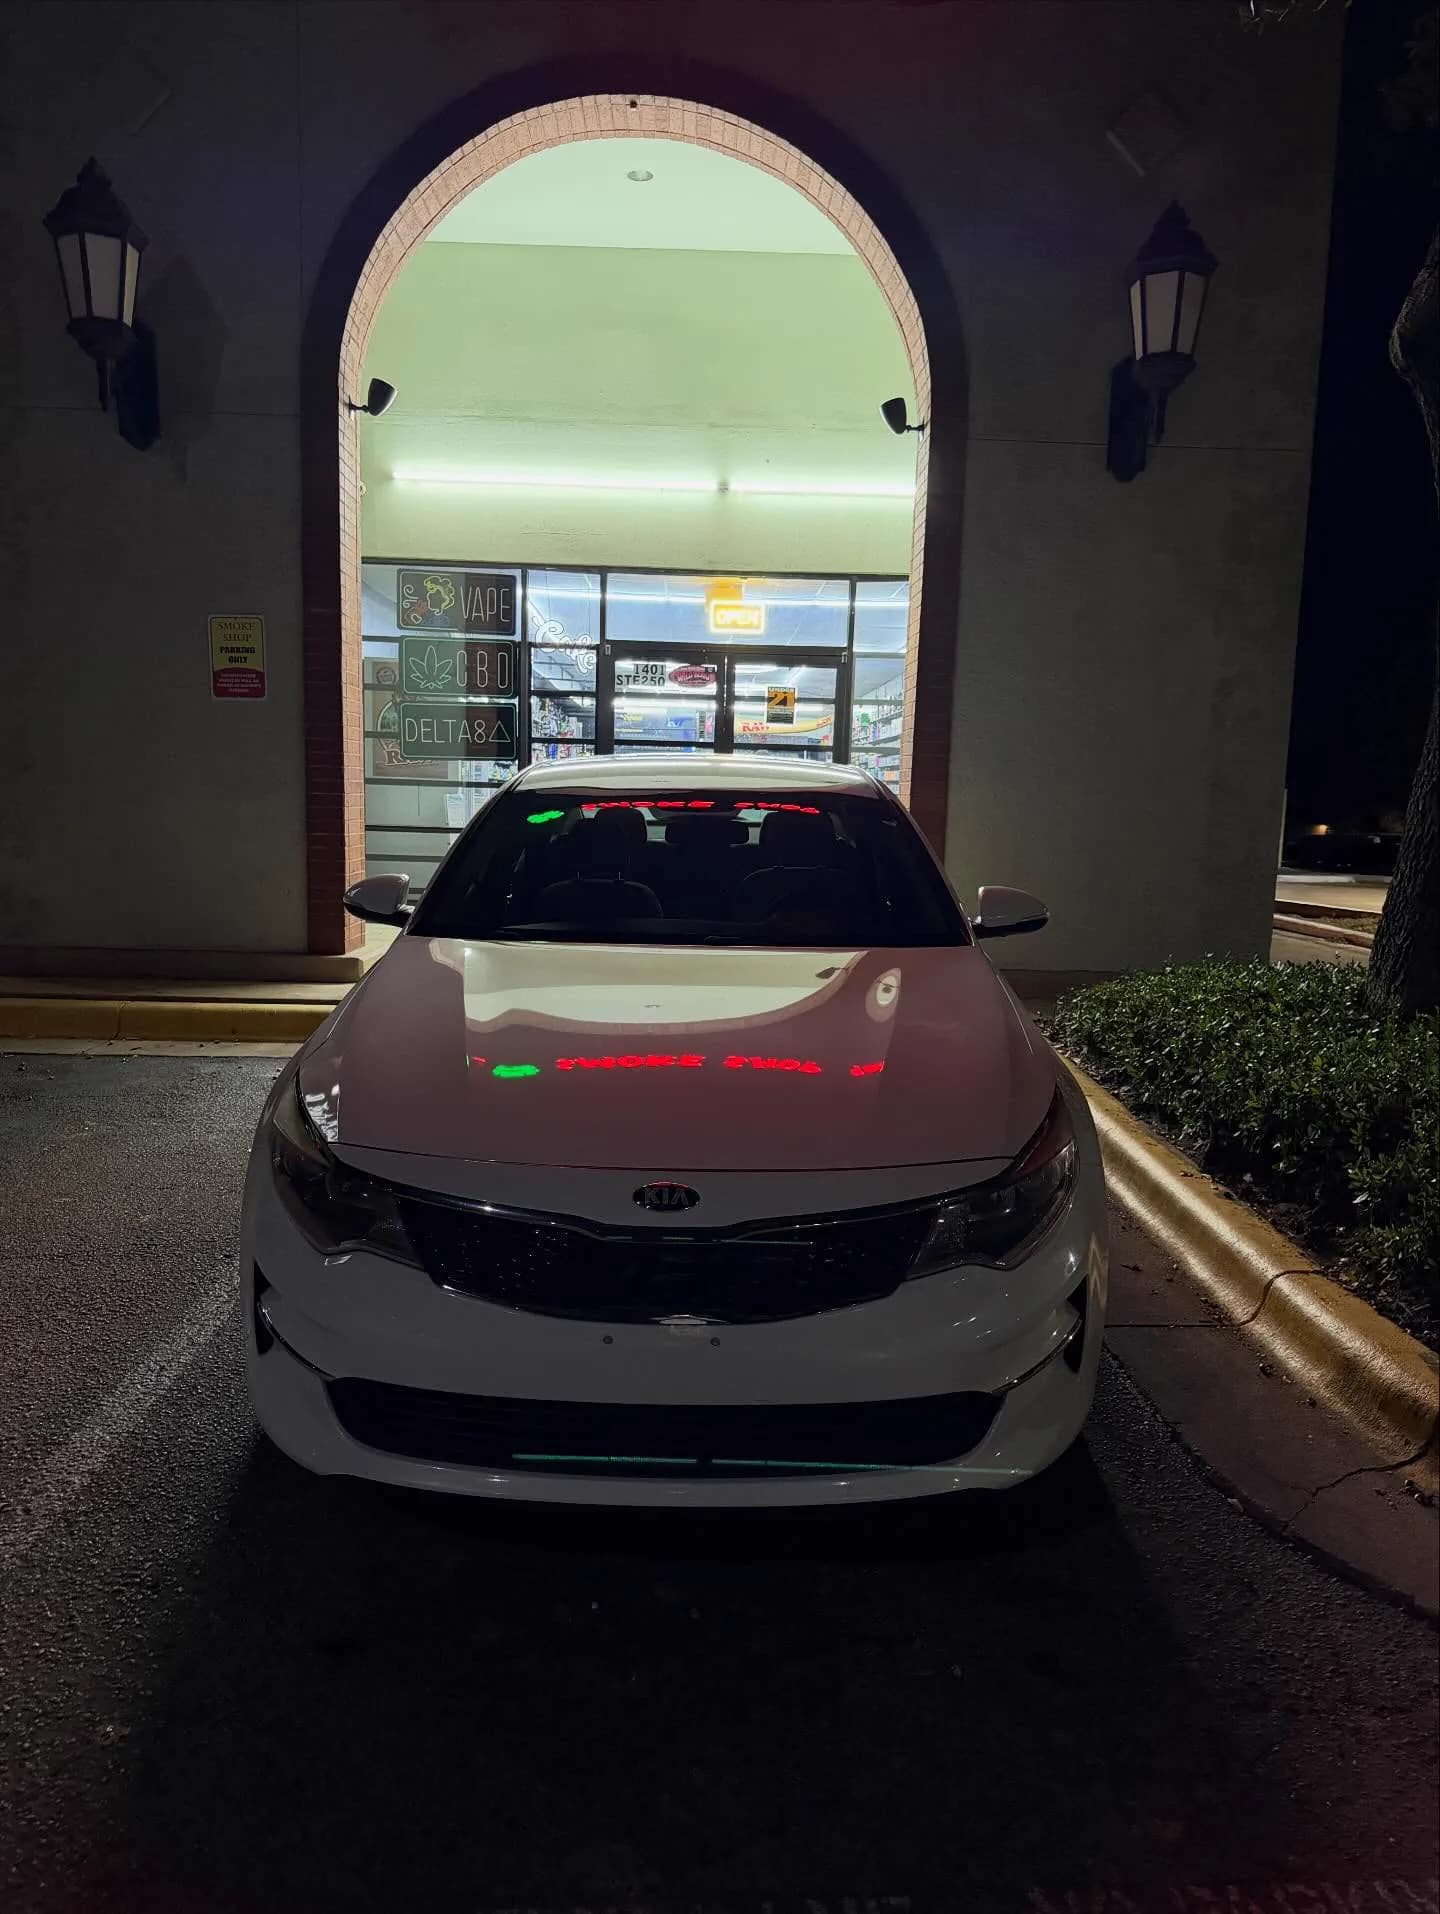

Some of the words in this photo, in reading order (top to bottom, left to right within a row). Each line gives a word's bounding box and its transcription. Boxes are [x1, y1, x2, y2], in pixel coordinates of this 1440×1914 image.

[460, 586, 511, 622] VAPE
[715, 607, 761, 625] OPEN
[218, 622, 256, 631] SMOKE
[223, 633, 252, 642] SHOP
[228, 655, 248, 664] ONLY
[634, 663, 665, 675] 1401
[768, 692, 794, 707] 21
[644, 1187, 689, 1205] KIA
